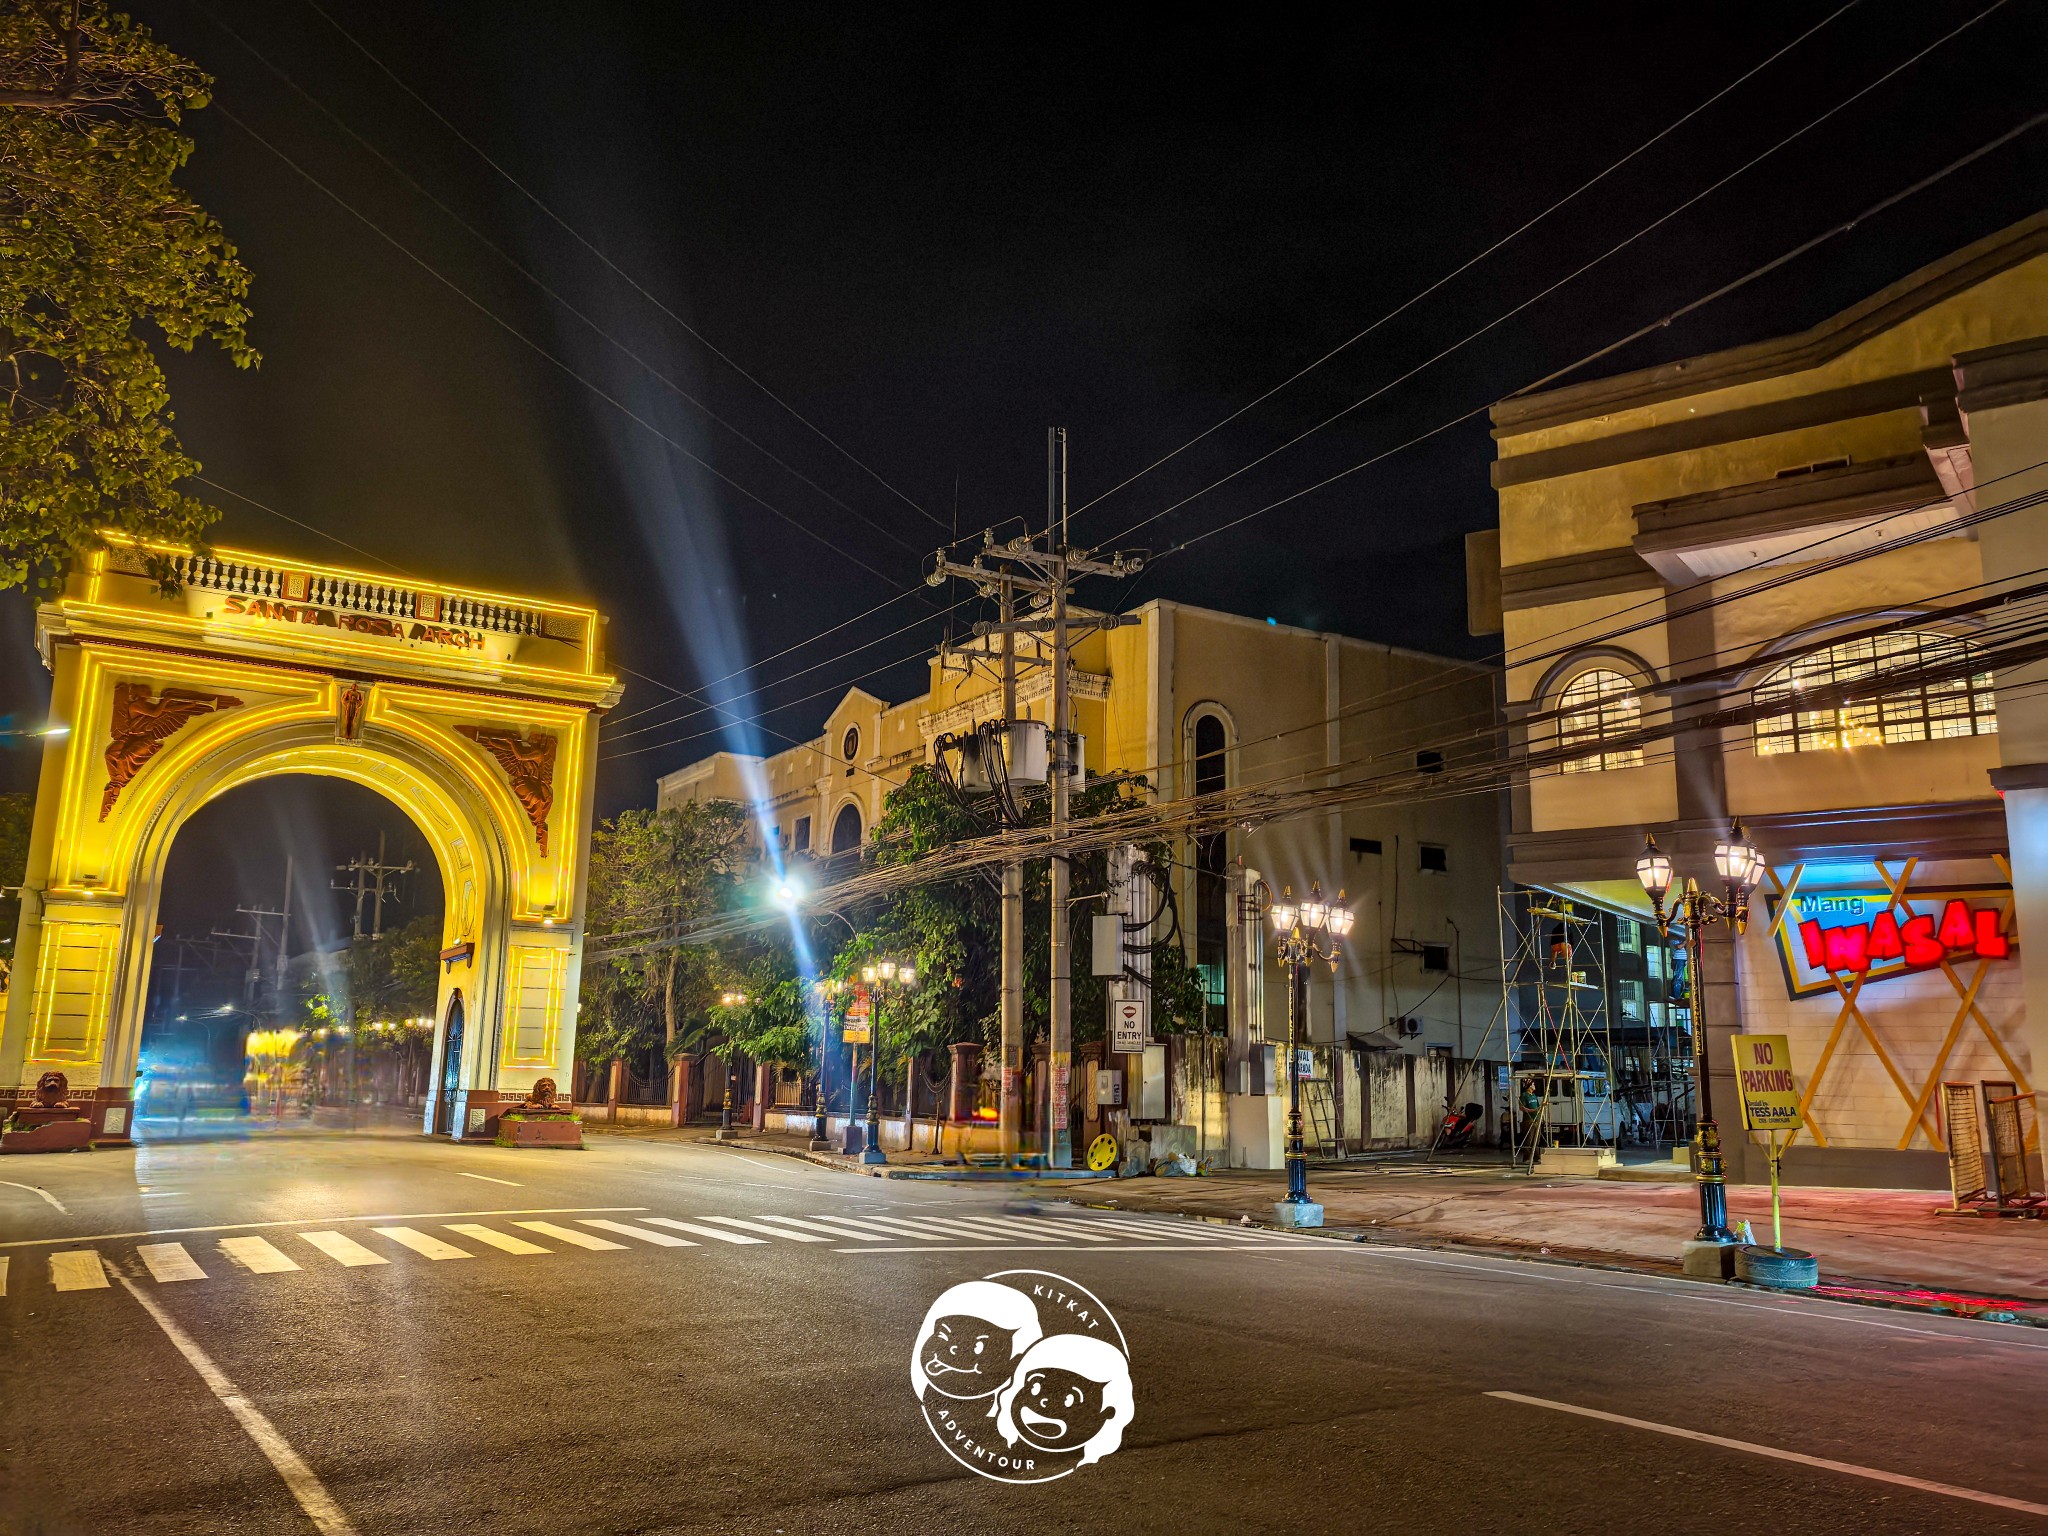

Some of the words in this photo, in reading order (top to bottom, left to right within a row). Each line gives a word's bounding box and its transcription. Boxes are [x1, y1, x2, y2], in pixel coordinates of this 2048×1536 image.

[223, 596, 320, 626] SANTA
[337, 614, 405, 639] ROSA
[421, 627, 486, 650] ARCH
[1800, 895, 1865, 916] Mang
[1798, 898, 2010, 974] INASAL
[1117, 1031, 1142, 1040] ENTRY
[1124, 1021, 1135, 1029] NO
[1753, 1043, 1773, 1065] NO
[1742, 1069, 1794, 1092] PARKING
[1750, 1107, 1771, 1117] TESS
[1772, 1106, 1797, 1117] AALA
